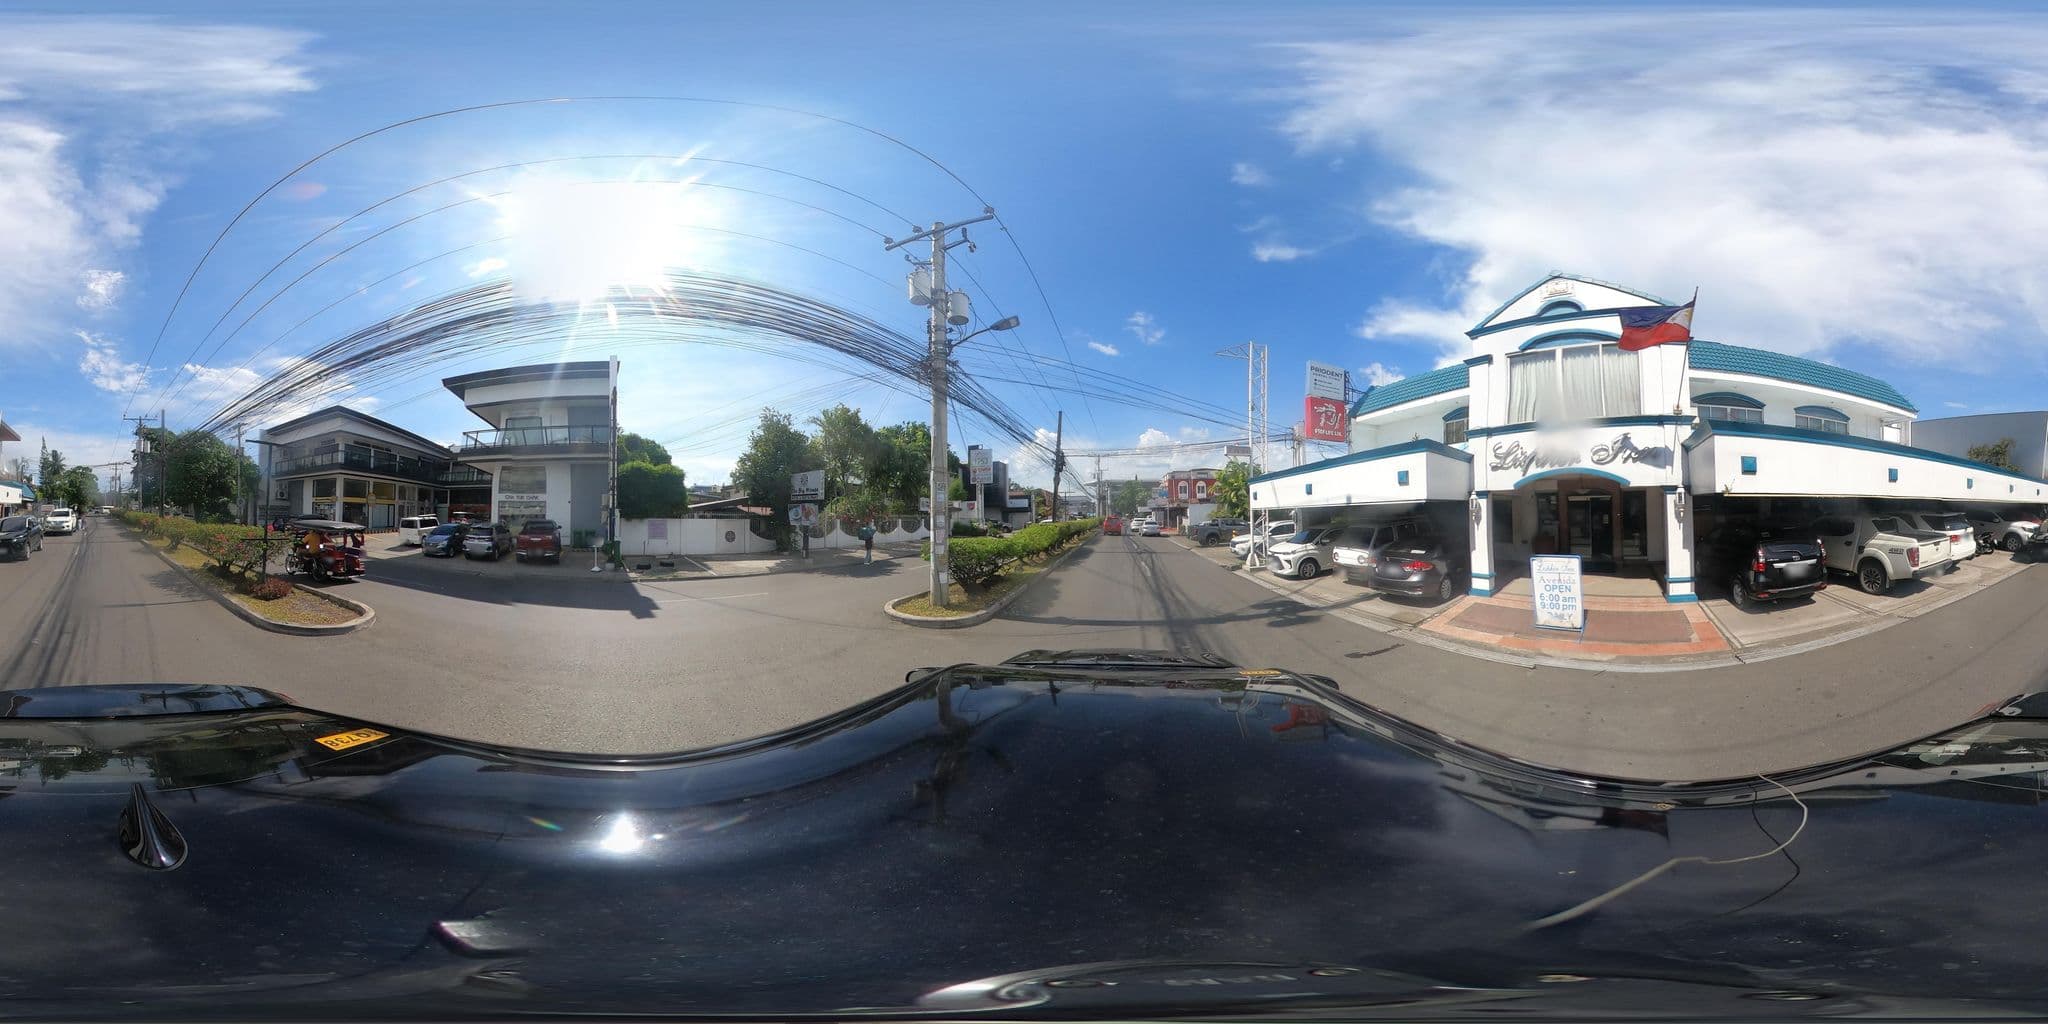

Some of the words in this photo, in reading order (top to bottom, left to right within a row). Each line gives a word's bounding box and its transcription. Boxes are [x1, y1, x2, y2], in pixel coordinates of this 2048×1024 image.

[1310, 366, 1343, 379] PRIODENT
[1538, 575, 1576, 584] Avenida
[1544, 584, 1572, 593] OPEN
[1539, 593, 1560, 602] 6:00
[1540, 601, 1560, 610] 9:00
[1562, 603, 1577, 611] pm
